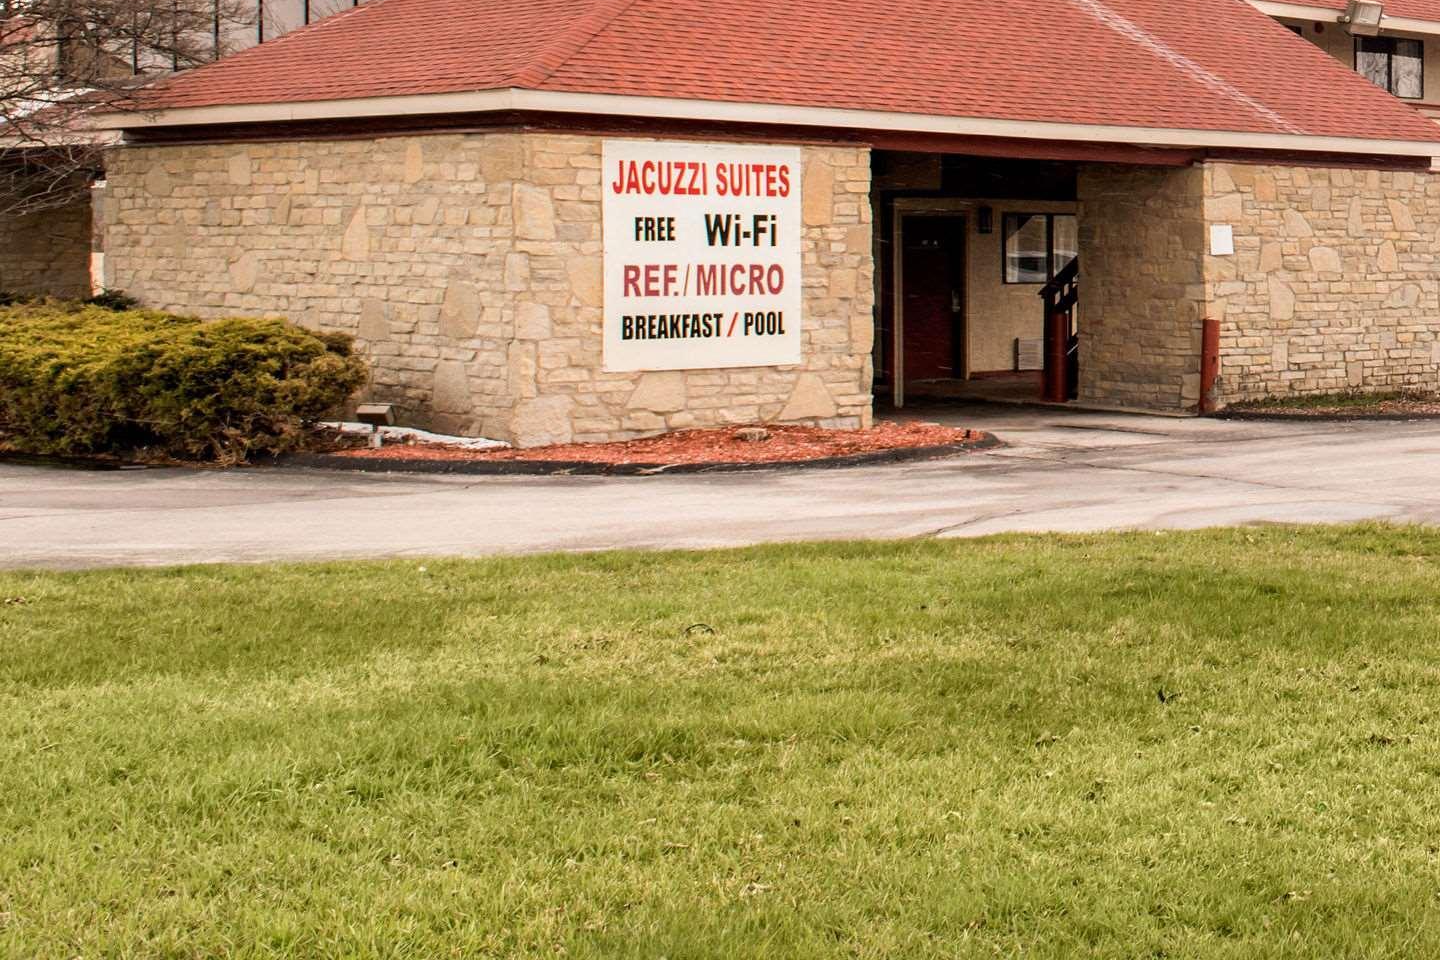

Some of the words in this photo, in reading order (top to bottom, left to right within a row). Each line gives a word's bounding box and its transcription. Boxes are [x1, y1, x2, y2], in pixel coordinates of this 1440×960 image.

[612, 160, 708, 195] JACUZZI
[716, 162, 790, 198] SUITES
[634, 216, 676, 241] FREE
[704, 213, 777, 247] Wi-Fi
[622, 313, 723, 340] BREAKFAST
[744, 311, 785, 336] POOL
